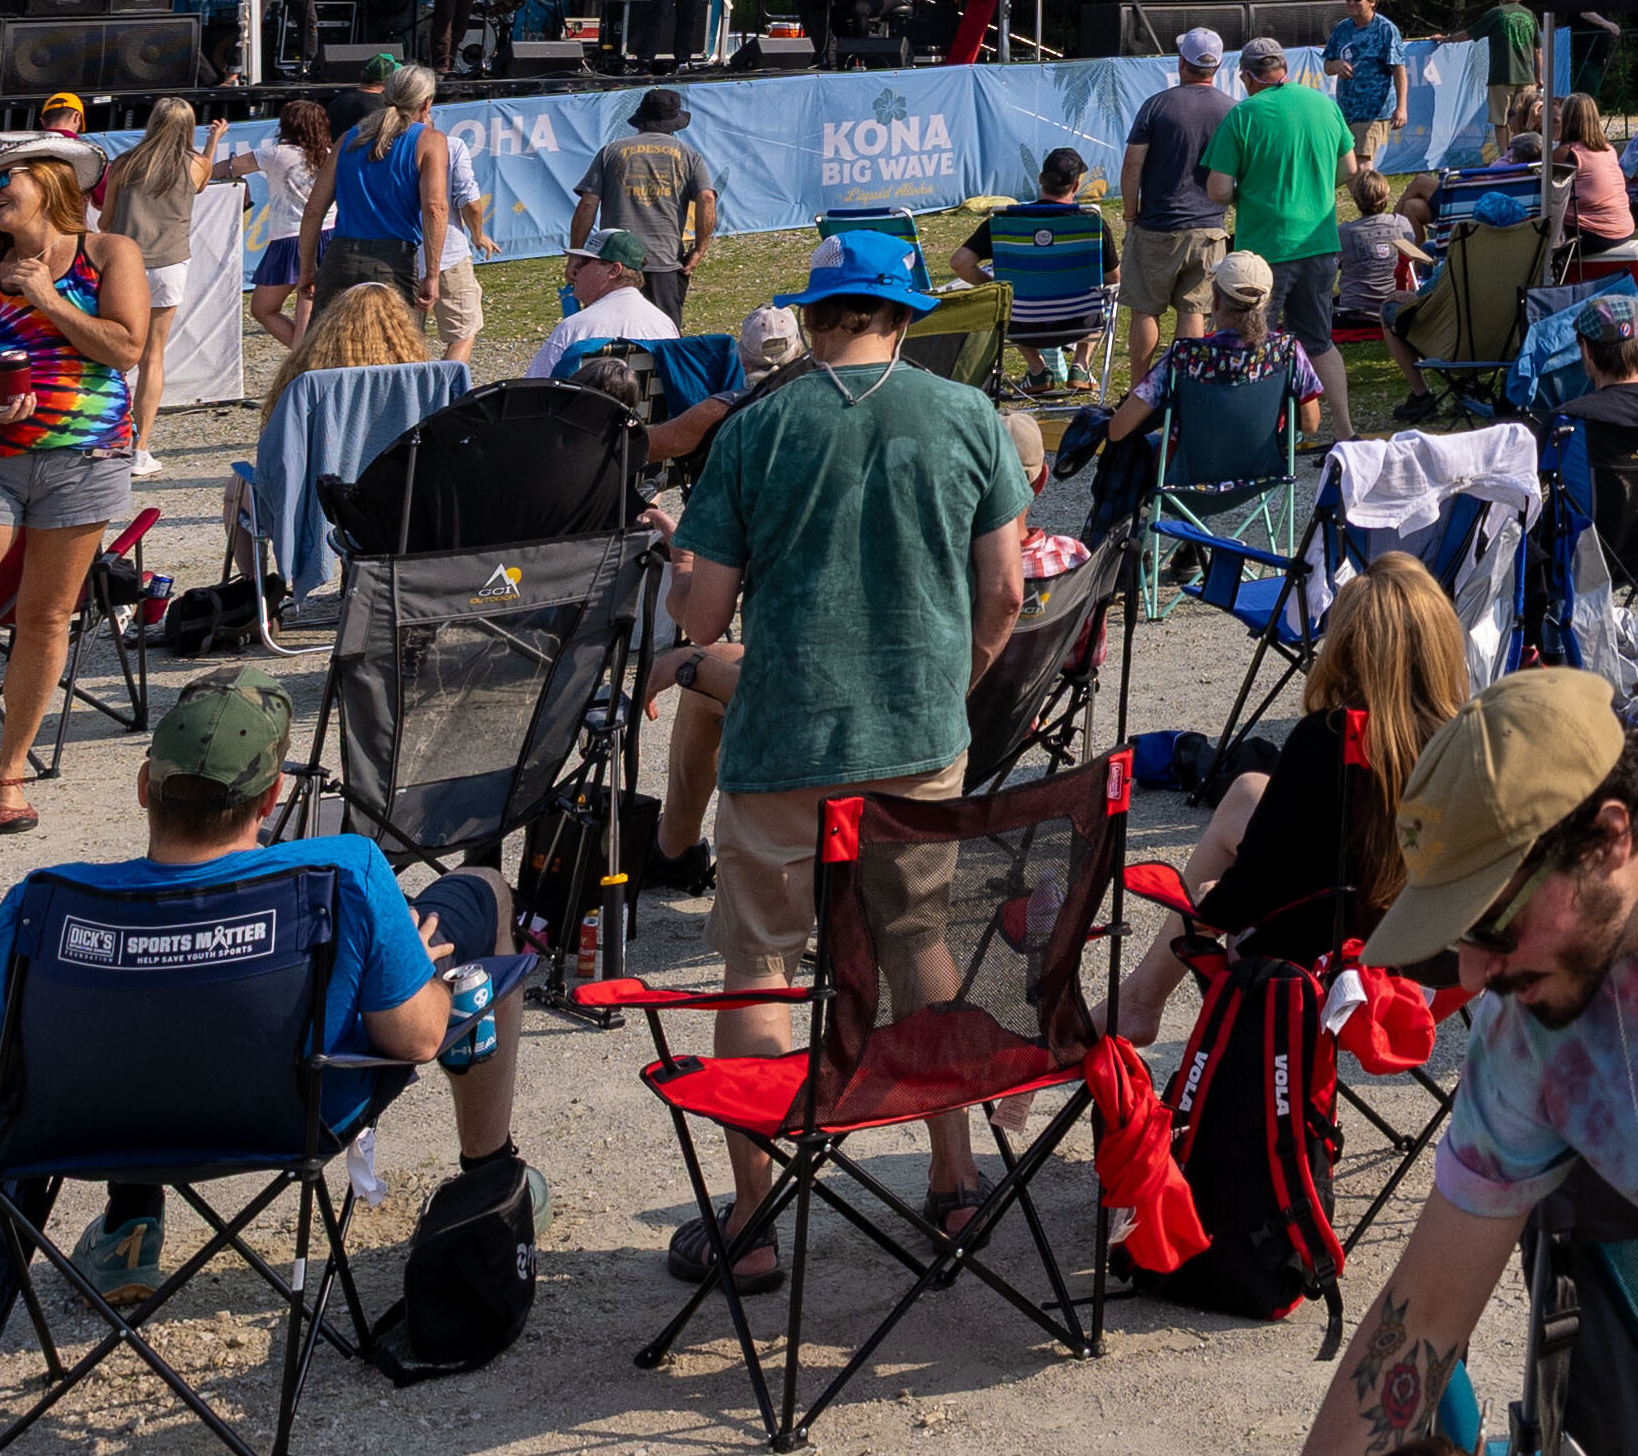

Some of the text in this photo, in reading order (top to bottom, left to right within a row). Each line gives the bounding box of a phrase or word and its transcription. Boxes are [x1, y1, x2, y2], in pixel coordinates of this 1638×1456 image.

[823, 114, 952, 161] KONA
[821, 152, 955, 186] BIG WAVE
[478, 586, 511, 597] GCI
[70, 928, 113, 950] DICK'S
[127, 934, 192, 954] SPORTS
[137, 944, 253, 964] HELP SAVE YOUTH SPORTS
[1179, 1051, 1209, 1112] VOLA
[1275, 1054, 1290, 1116] VOLA
